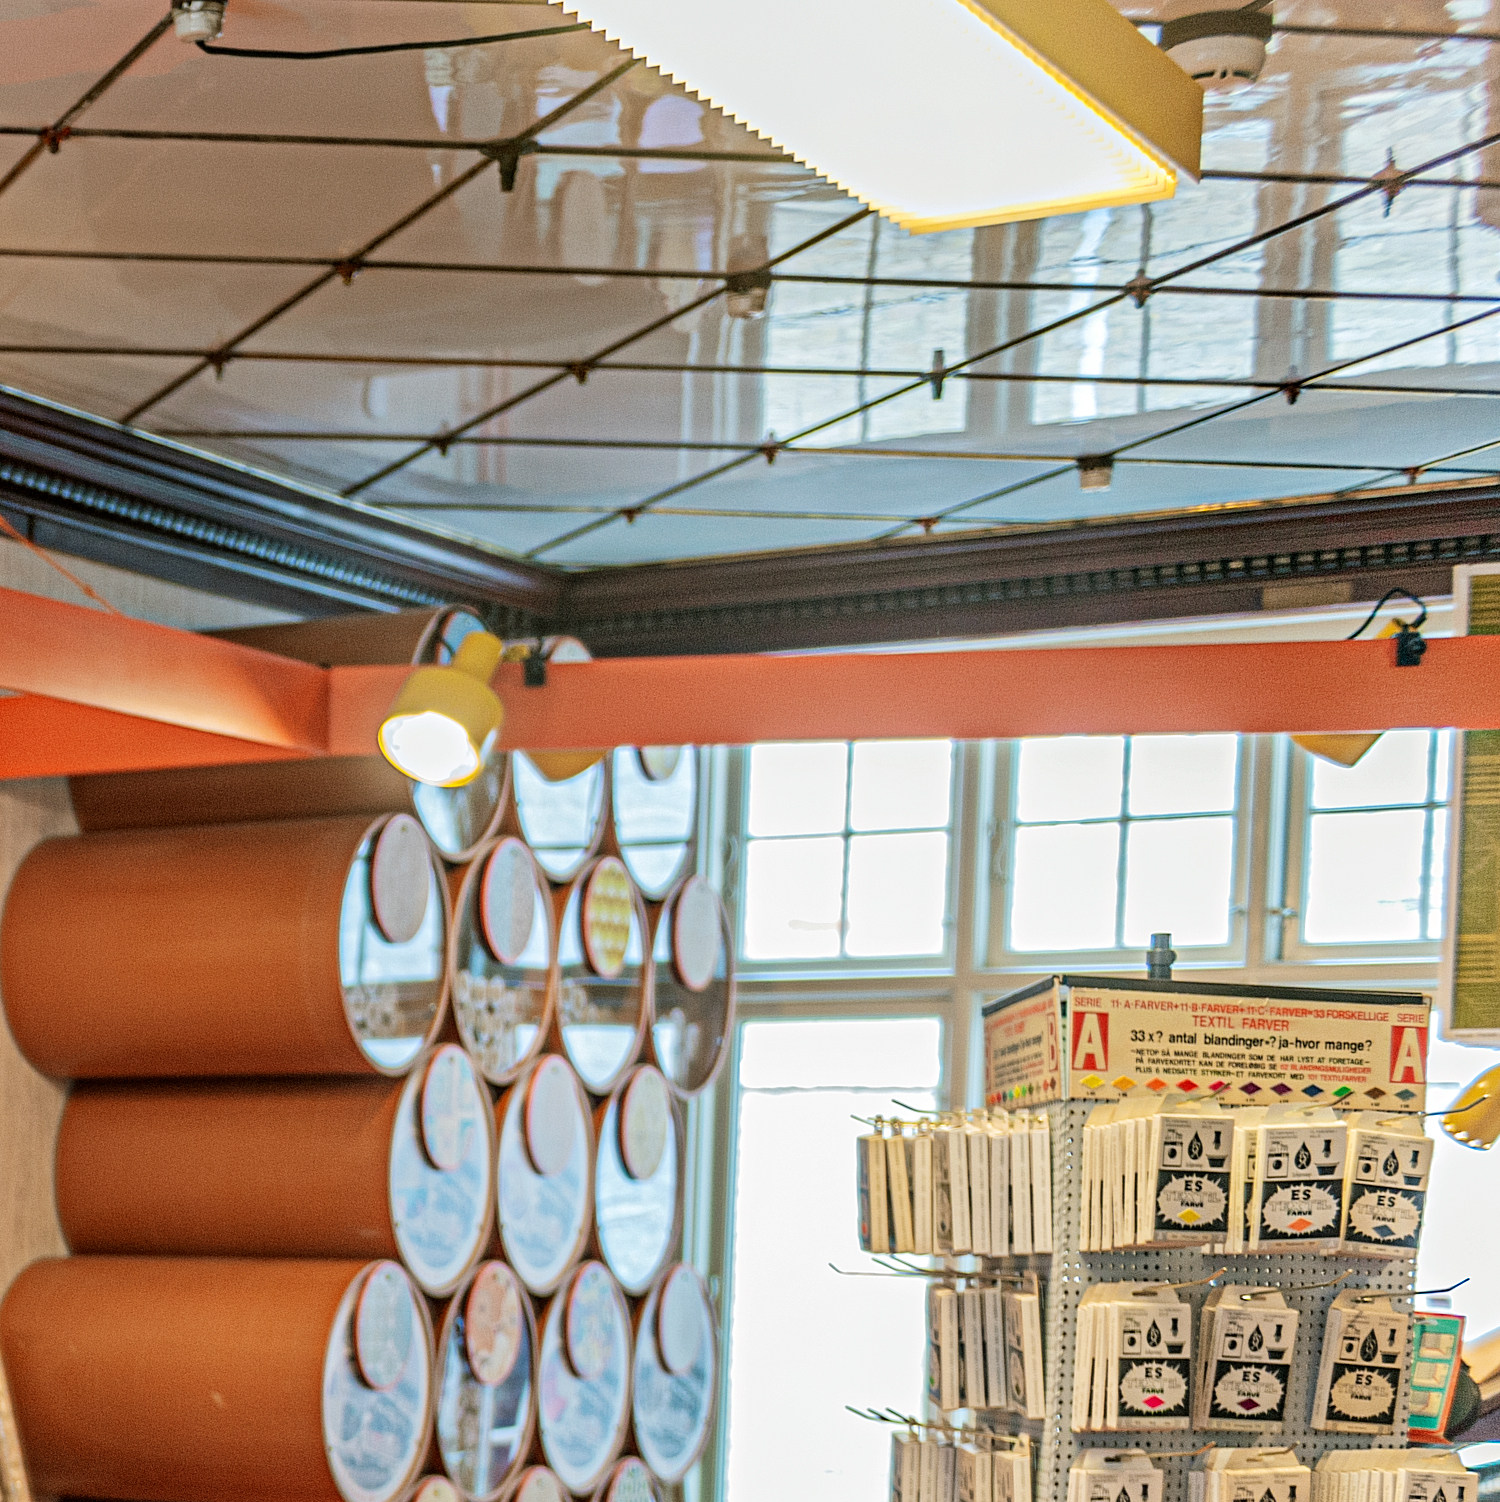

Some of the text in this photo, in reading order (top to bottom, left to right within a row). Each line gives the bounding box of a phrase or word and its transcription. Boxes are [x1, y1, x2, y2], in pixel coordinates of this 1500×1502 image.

[1074, 996, 1102, 1009] SERIE
[1326, 1009, 1389, 1022] FORSKELLIGE
[1397, 1012, 1425, 1024] SERIE
[1191, 1015, 1290, 1032] TEXTIL FARVER
[1074, 1013, 1107, 1070] A
[1130, 1029, 1373, 1053] 33 antal ja-hvor mange?
[1174, 1050, 1199, 1058] MANGE
[1202, 1051, 1246, 1060] BLANDINGER
[1248, 1053, 1264, 1061] SOM
[1266, 1054, 1276, 1062] DE
[1279, 1054, 1294, 1063] HAR
[1297, 1055, 1314, 1064] LYST
[1317, 1056, 1326, 1064] AT
[1392, 1026, 1426, 1083] A
[1162, 1067, 1198, 1076] NEDSATTE
[1247, 1070, 1287, 1079] FARVEKORT
[1318, 1074, 1367, 1083] TEXTILFARVER
[1184, 1180, 1203, 1191] ES
[1291, 1189, 1312, 1201] ES
[1145, 1366, 1163, 1378] ES
